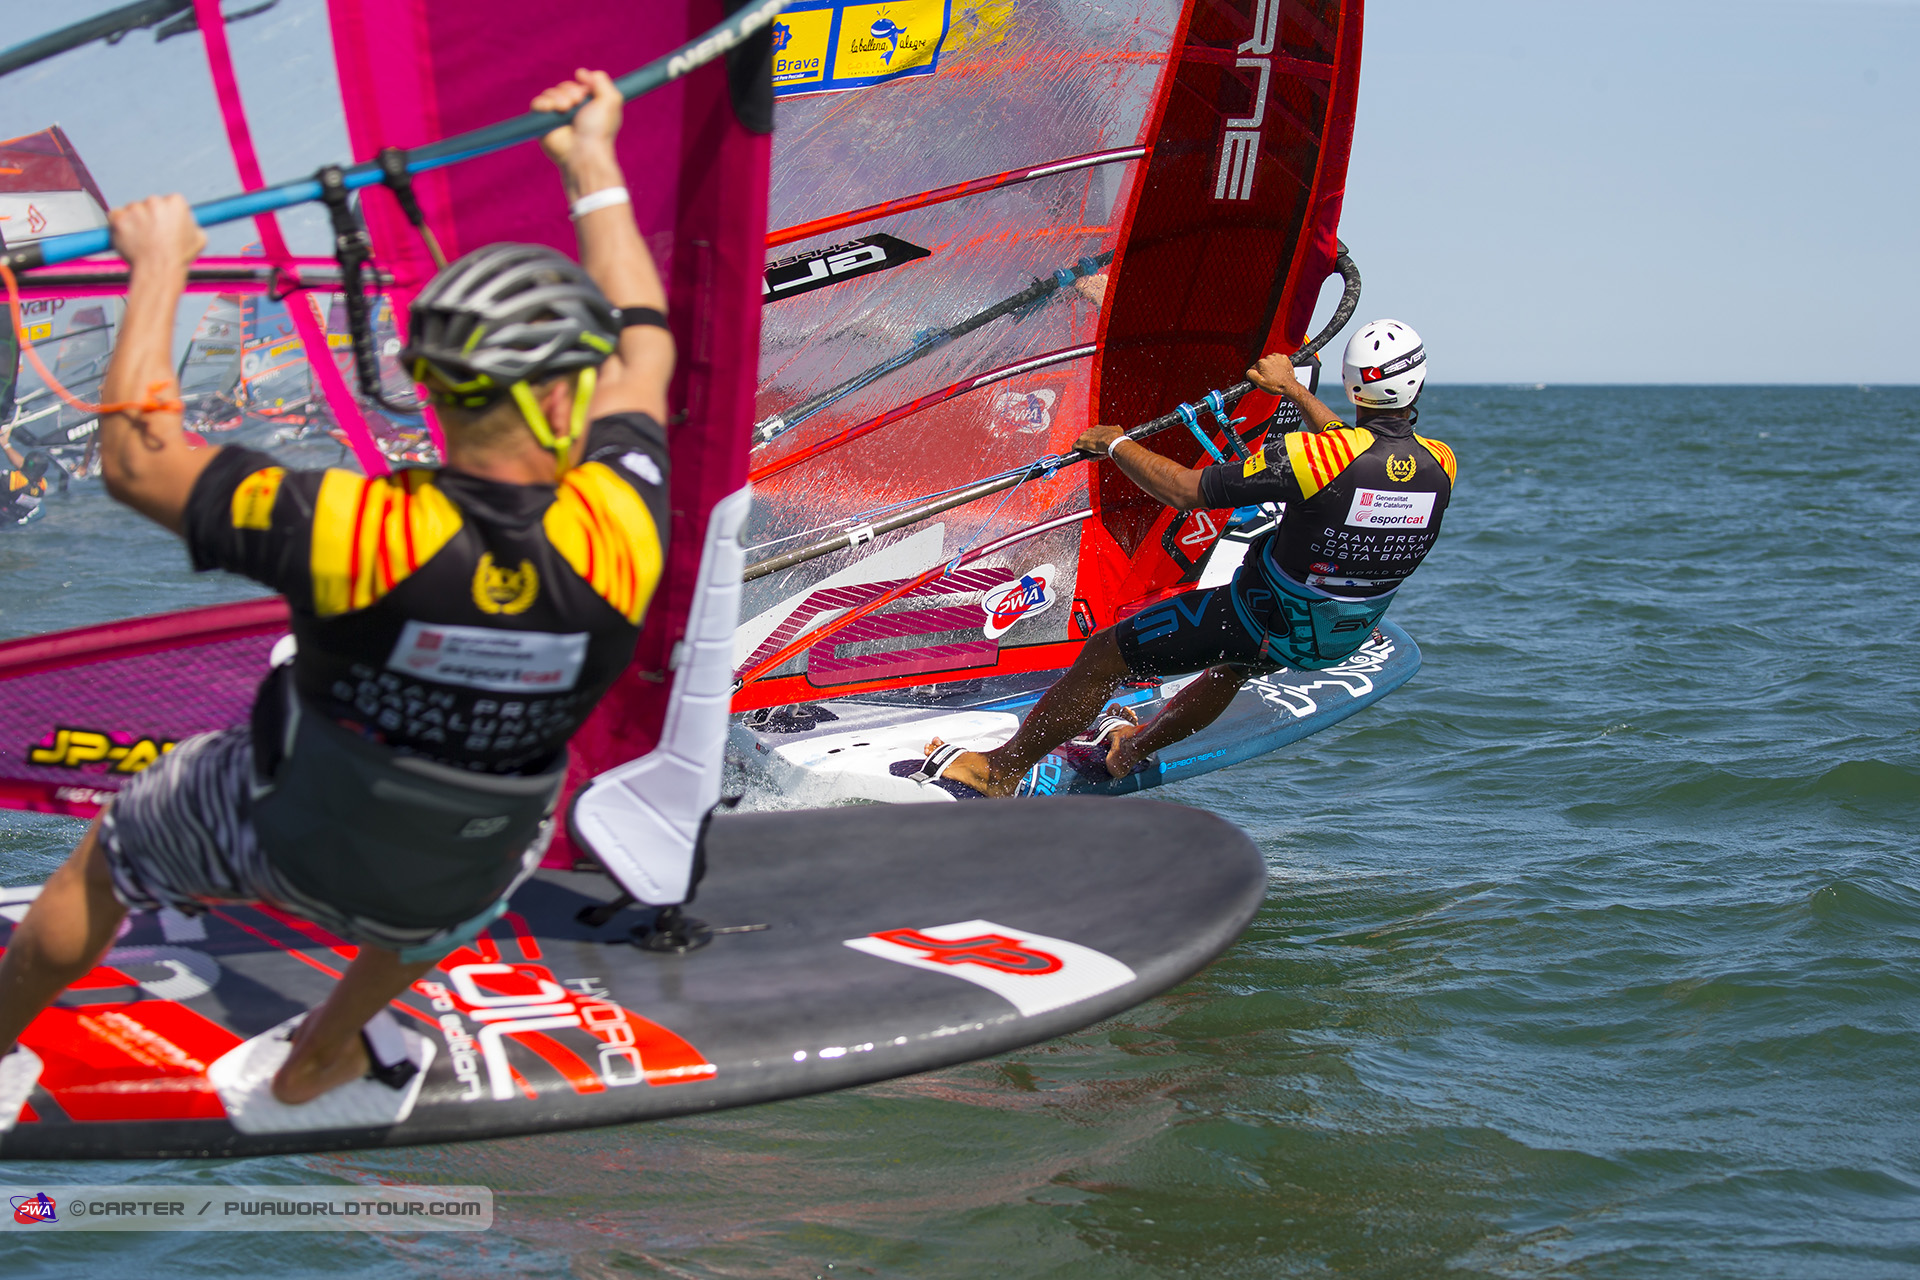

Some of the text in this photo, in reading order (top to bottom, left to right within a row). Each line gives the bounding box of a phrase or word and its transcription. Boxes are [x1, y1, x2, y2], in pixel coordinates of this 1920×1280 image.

[776, 57, 819, 72] Brava
[1393, 460, 1411, 472] XX
[1370, 515, 1424, 525] esportcat
[1324, 528, 1435, 543] GRAN PREMI
[1310, 543, 1428, 561] COSTA BRAVA
[1326, 539, 1424, 553] CATALUNYA
[998, 588, 1040, 618] PWA
[31, 729, 176, 773] JP-A
[564, 977, 644, 1087] HYDRO
